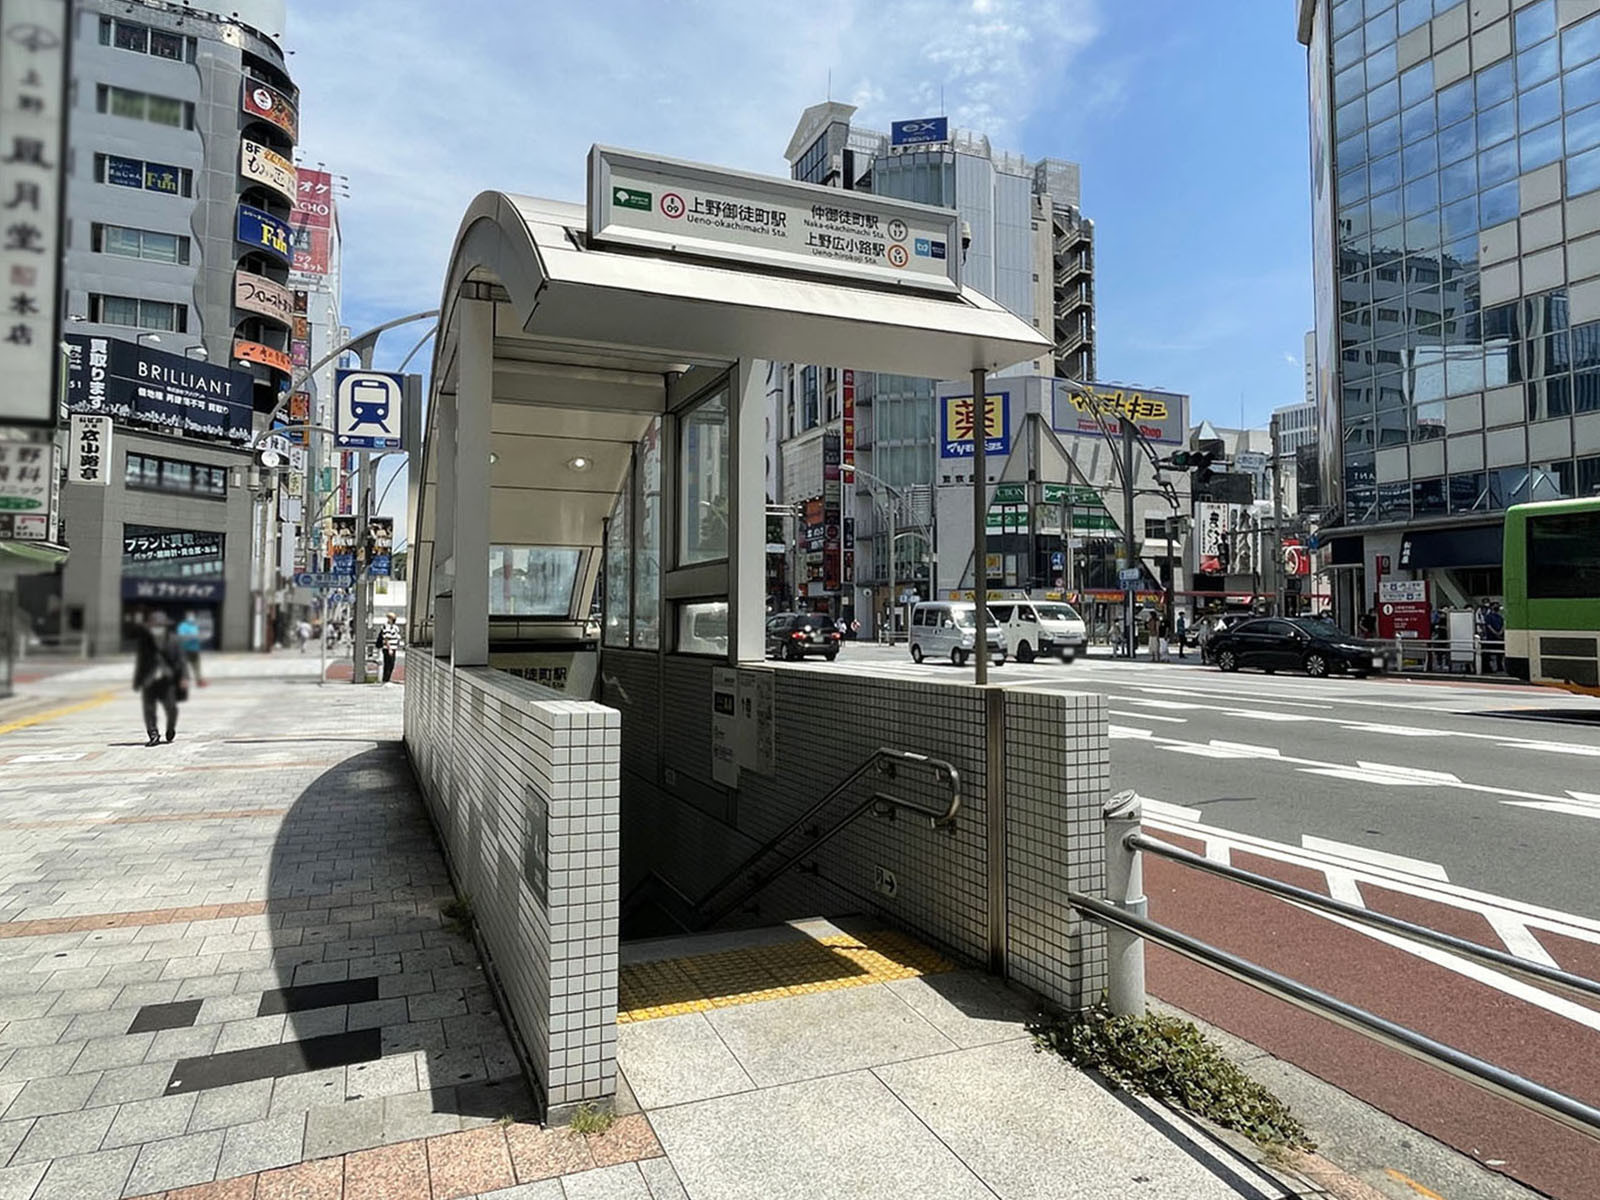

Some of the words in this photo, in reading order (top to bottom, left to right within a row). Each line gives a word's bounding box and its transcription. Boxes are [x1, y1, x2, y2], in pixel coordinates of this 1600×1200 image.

[245, 142, 262, 155] 8F
[666, 204, 680, 214] 09
[688, 196, 788, 229] 上野御徒町駅
[811, 204, 880, 230] 仲御徒町駅
[687, 214, 770, 235] Ueno-okachimachi
[771, 228, 789, 238] Sta.
[803, 219, 871, 237] Naka-okachimachi
[872, 230, 886, 239] Sta.
[893, 229, 903, 239] 17
[261, 222, 289, 256] Fun
[804, 231, 887, 258] 上野広小路駅
[811, 249, 863, 264] Ueno-hirokoji
[864, 256, 878, 265] Sta.
[893, 255, 903, 264] 15
[89, 338, 108, 410] 買取ります
[137, 361, 233, 397] BRILLIANT
[954, 399, 995, 439] 薬
[124, 533, 195, 551] ブランド買取
